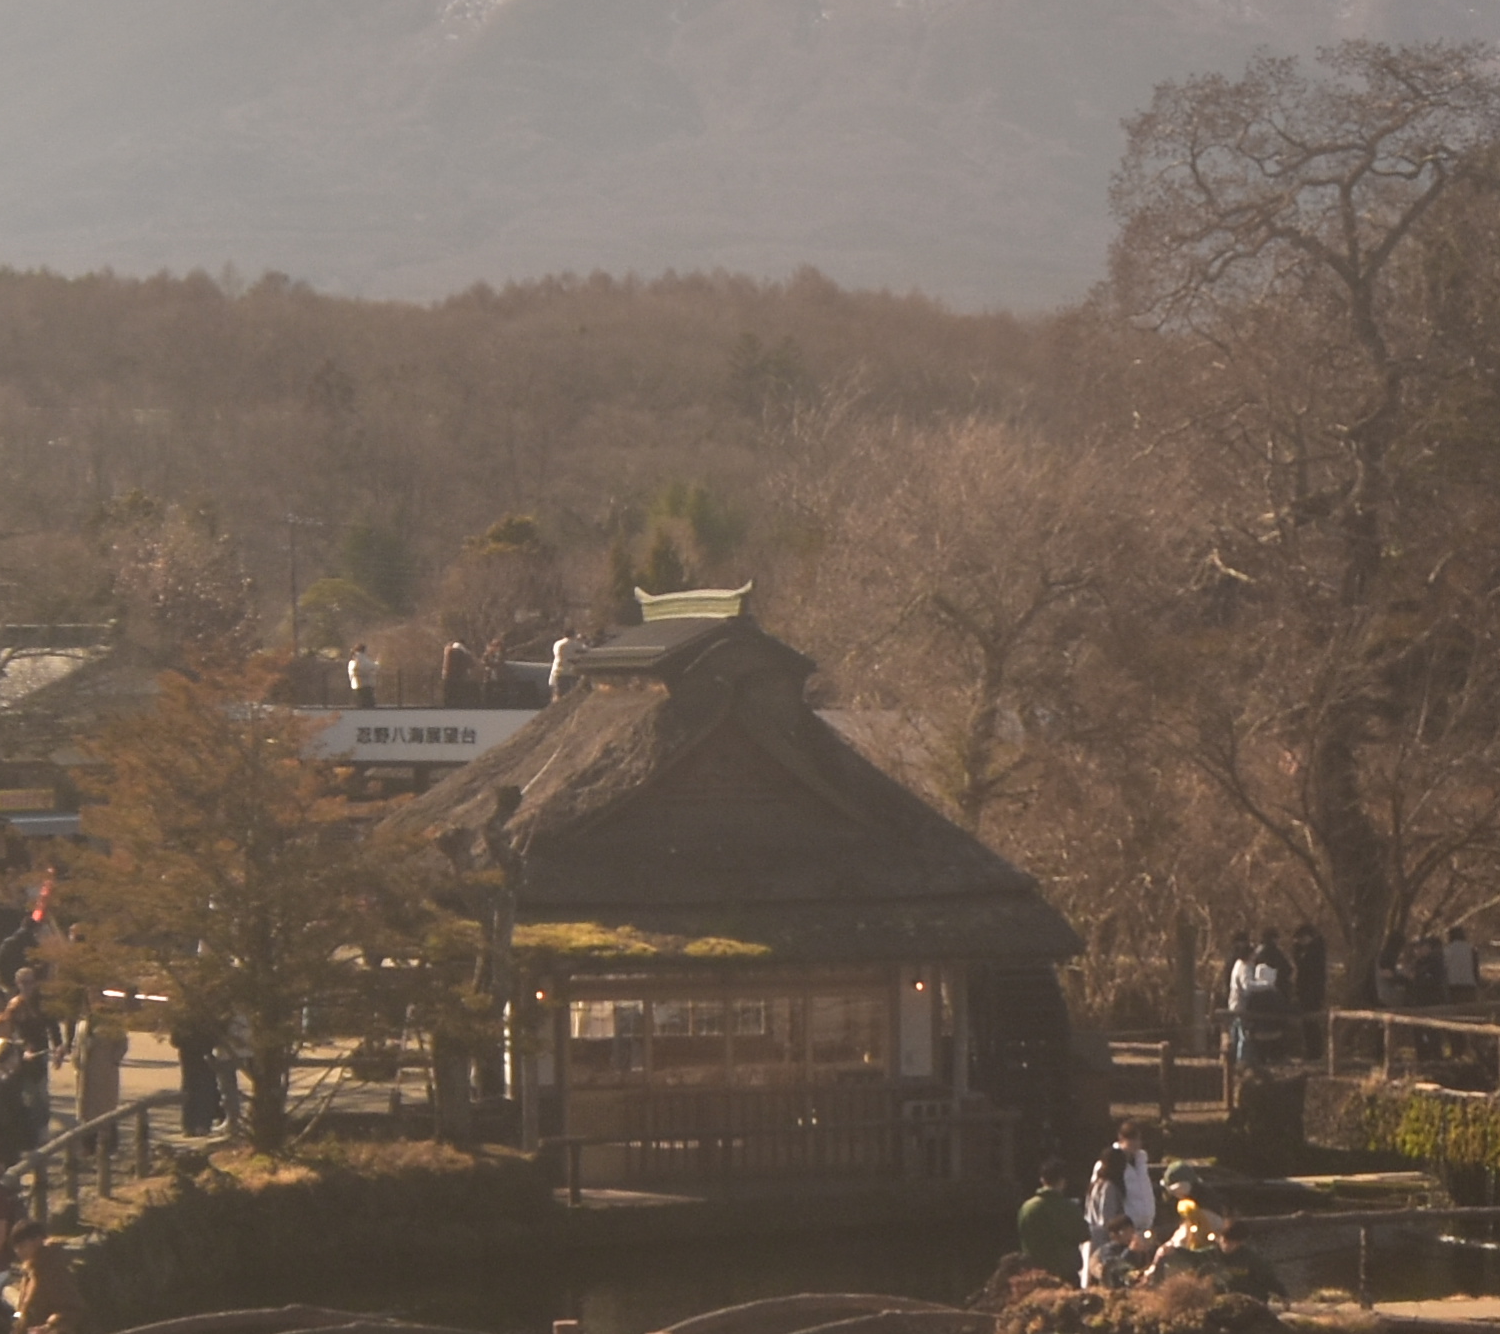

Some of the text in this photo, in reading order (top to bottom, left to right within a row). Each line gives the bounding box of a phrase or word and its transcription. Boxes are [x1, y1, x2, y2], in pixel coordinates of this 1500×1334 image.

[356, 726, 477, 744] 忍野八海展望台
